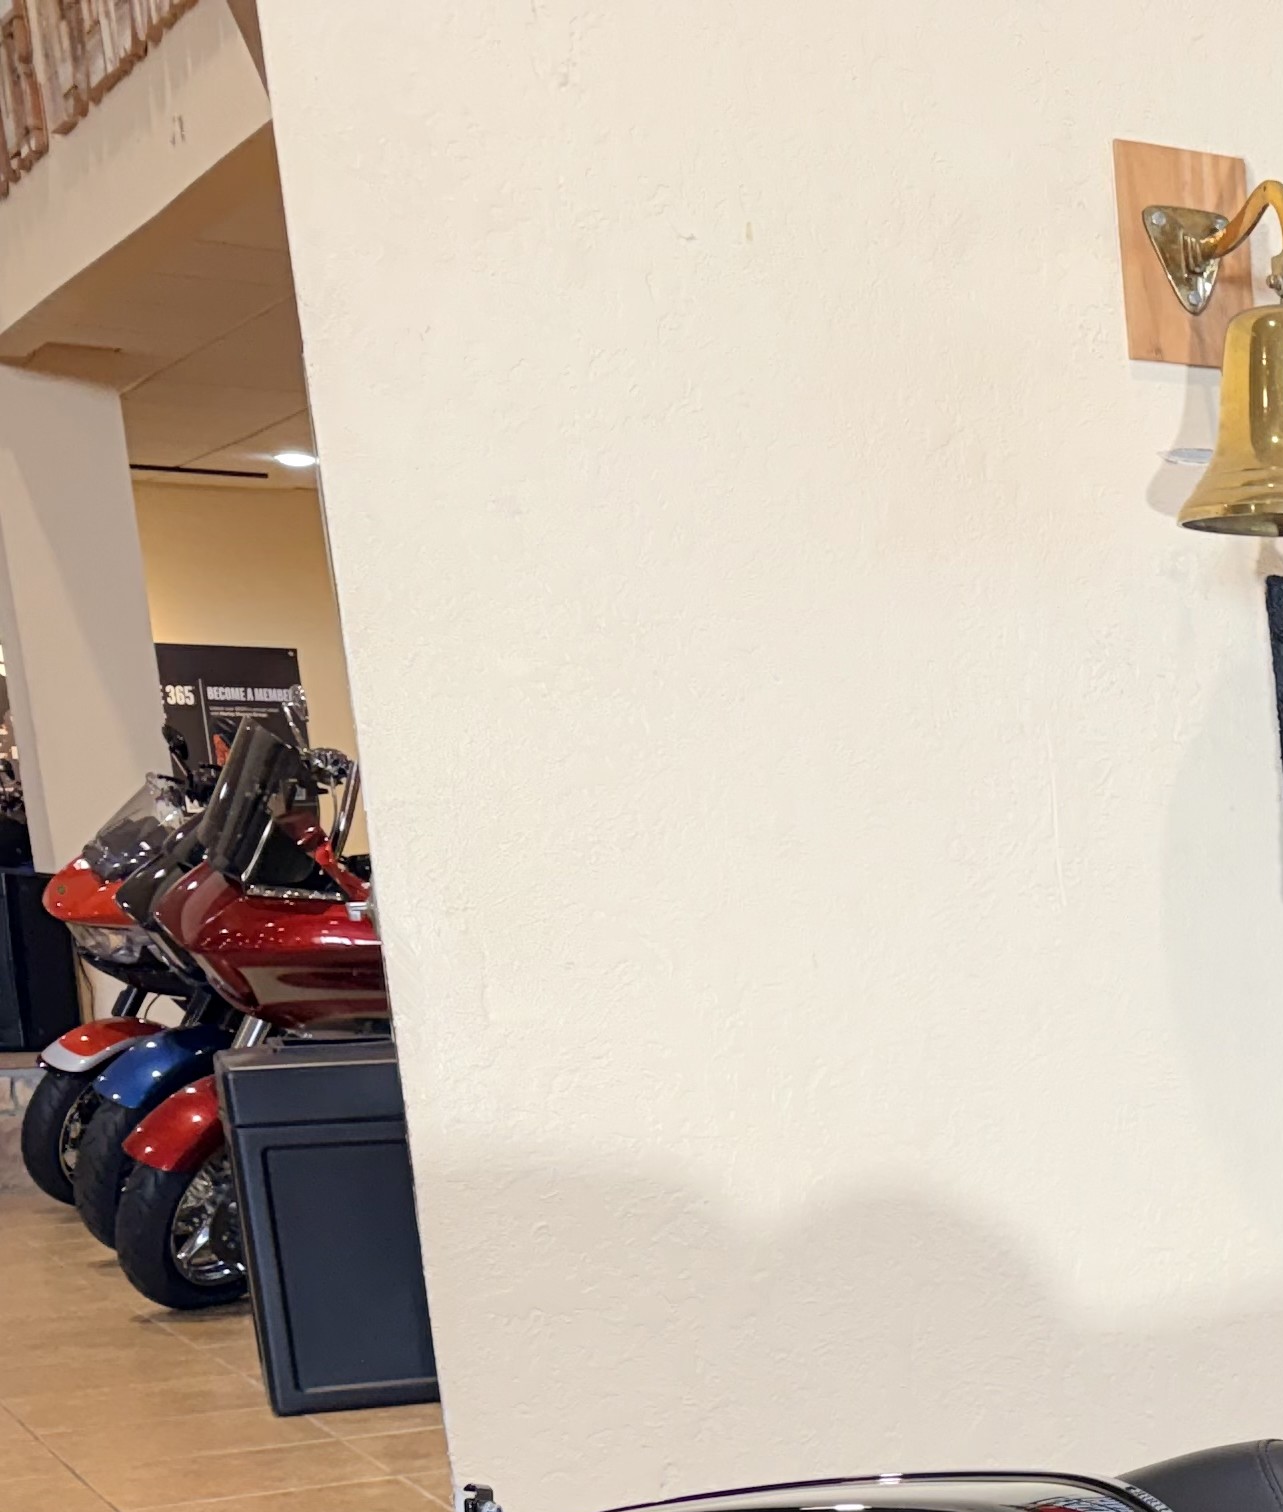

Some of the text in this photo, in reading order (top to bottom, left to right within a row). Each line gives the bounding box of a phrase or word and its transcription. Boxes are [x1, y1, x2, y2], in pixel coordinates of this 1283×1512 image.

[165, 685, 195, 705] 365
[206, 686, 246, 701] BECOME
[246, 687, 254, 701] A
